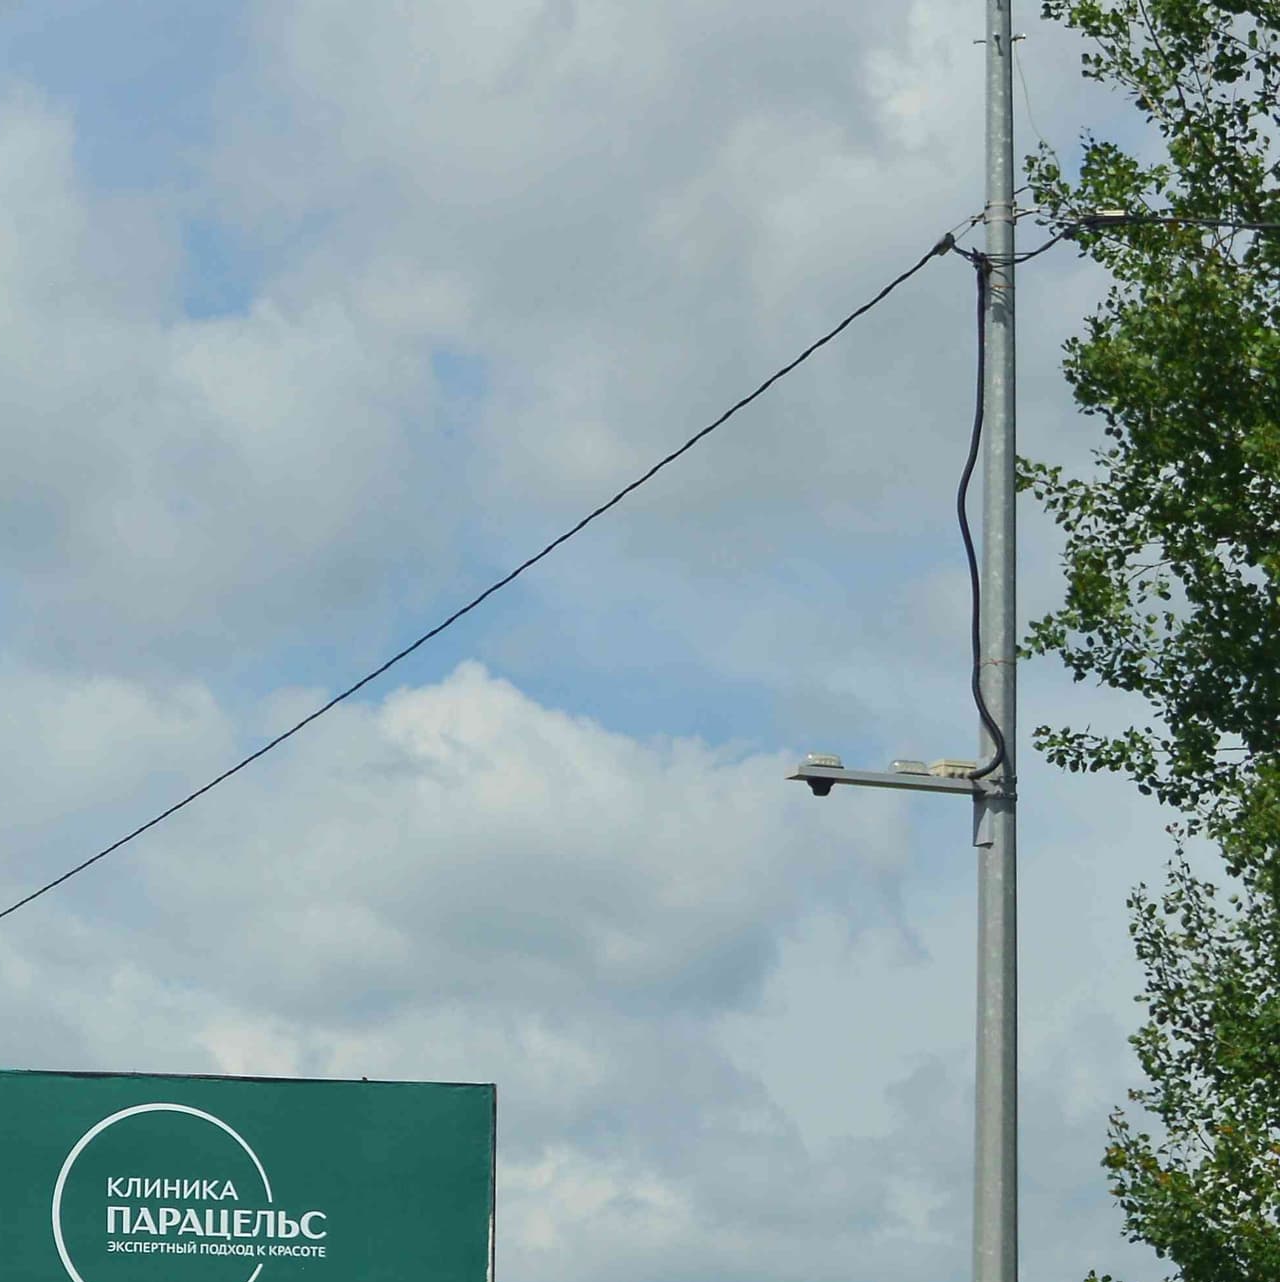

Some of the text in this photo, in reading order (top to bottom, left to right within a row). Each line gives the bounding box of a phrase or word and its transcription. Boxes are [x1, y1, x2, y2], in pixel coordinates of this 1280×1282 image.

[107, 1177, 239, 1201] КЛИНИКА
[106, 1206, 328, 1240] ПАРАЦЕЛЬС
[107, 1241, 326, 1257] ЭКСПЕРТНЫЙ ПОДХОД К КРАСОТЕ
